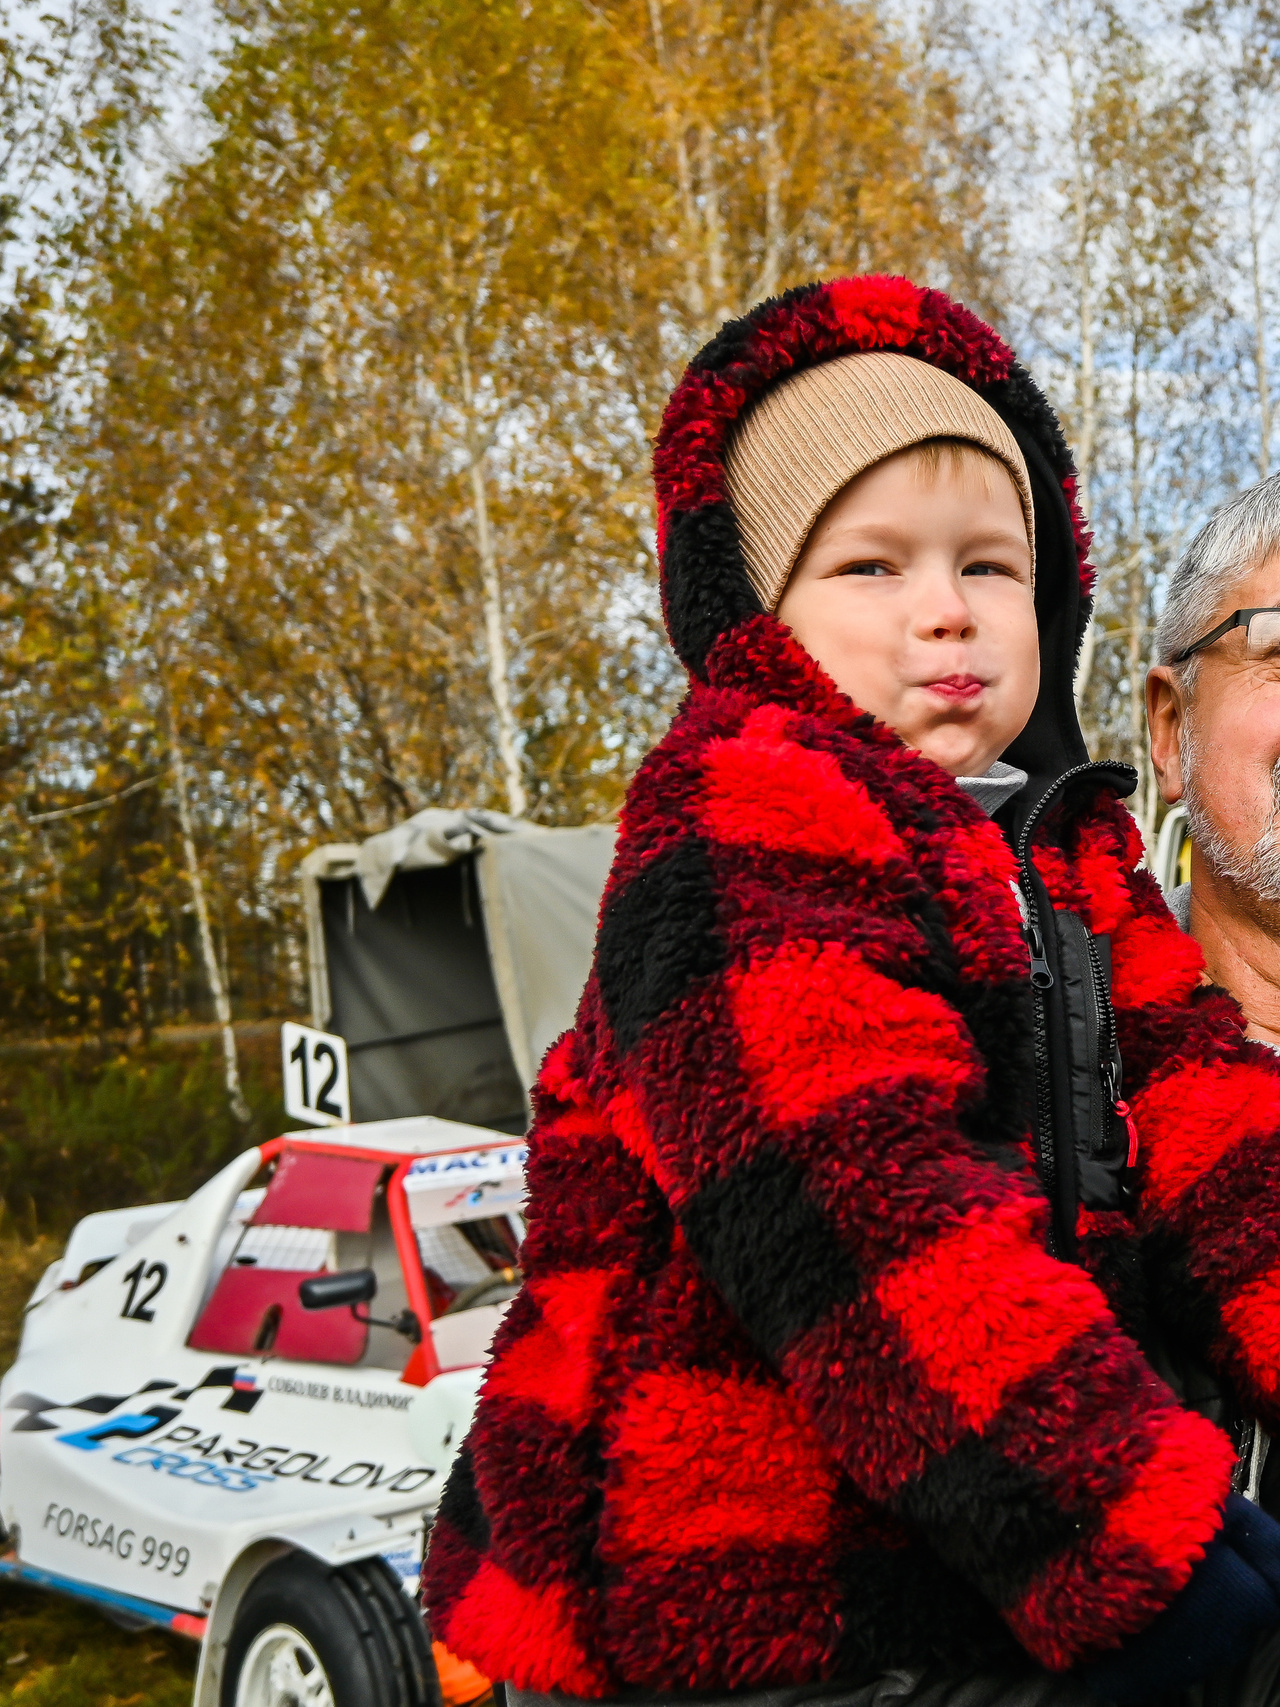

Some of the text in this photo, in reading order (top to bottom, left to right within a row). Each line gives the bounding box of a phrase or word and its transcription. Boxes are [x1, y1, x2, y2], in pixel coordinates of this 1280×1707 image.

[290, 1036, 342, 1118] 12
[120, 1258, 168, 1322] 12
[112, 1446, 276, 1493] CROSS
[151, 1425, 437, 1493] PARGOLOVO
[43, 1503, 191, 1577] FORSAG 999
